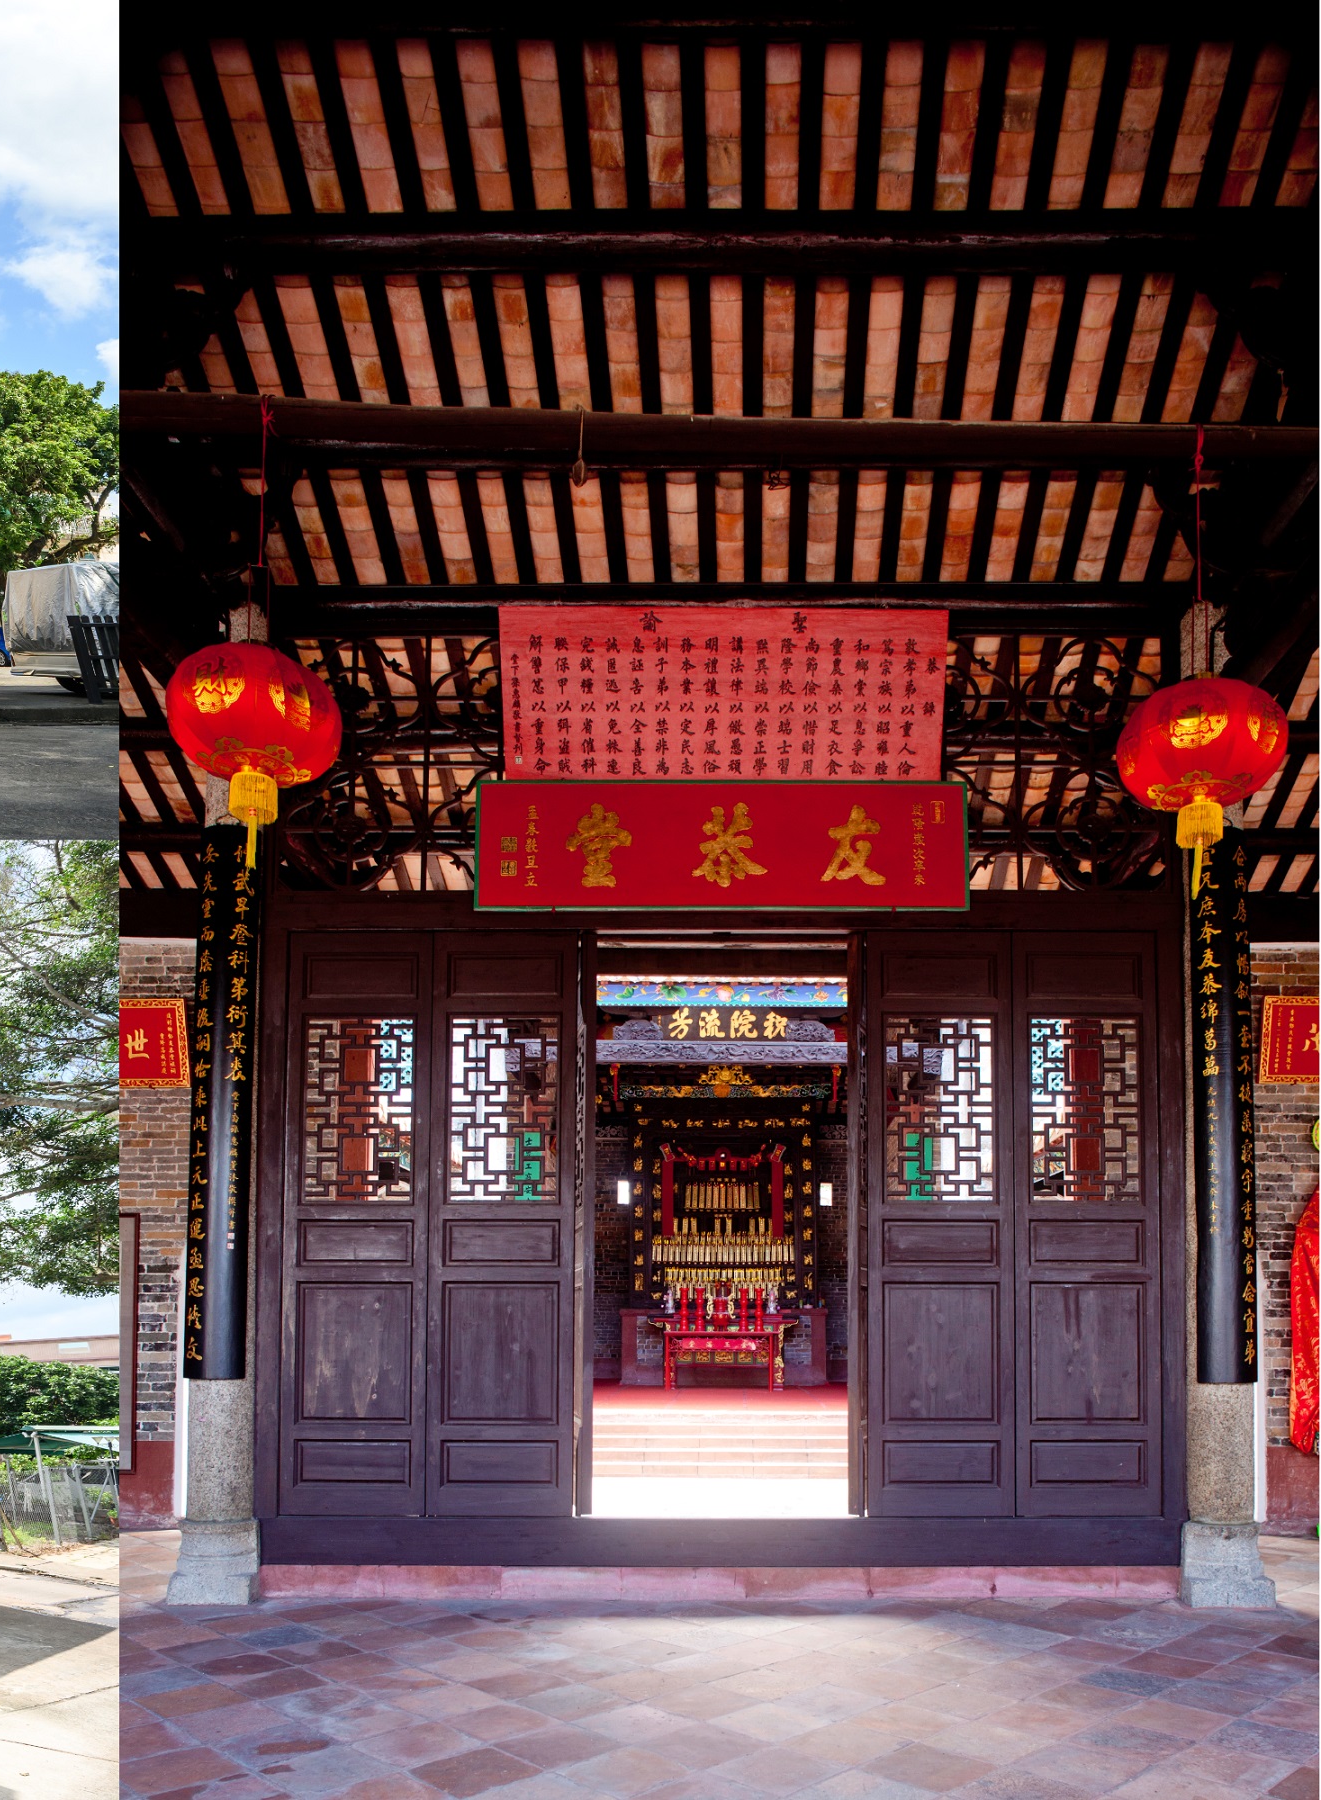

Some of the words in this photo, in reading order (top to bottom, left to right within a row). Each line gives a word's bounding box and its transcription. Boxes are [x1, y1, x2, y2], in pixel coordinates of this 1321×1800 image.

[191, 656, 228, 697] 財
[678, 636, 697, 776] 務本業以定民志
[702, 637, 723, 776] 明禮讓以厚風俗
[799, 637, 823, 777] 尚節儉以惜財用
[824, 636, 846, 777] 重農桑以足衣食
[123, 1028, 150, 1060] 世
